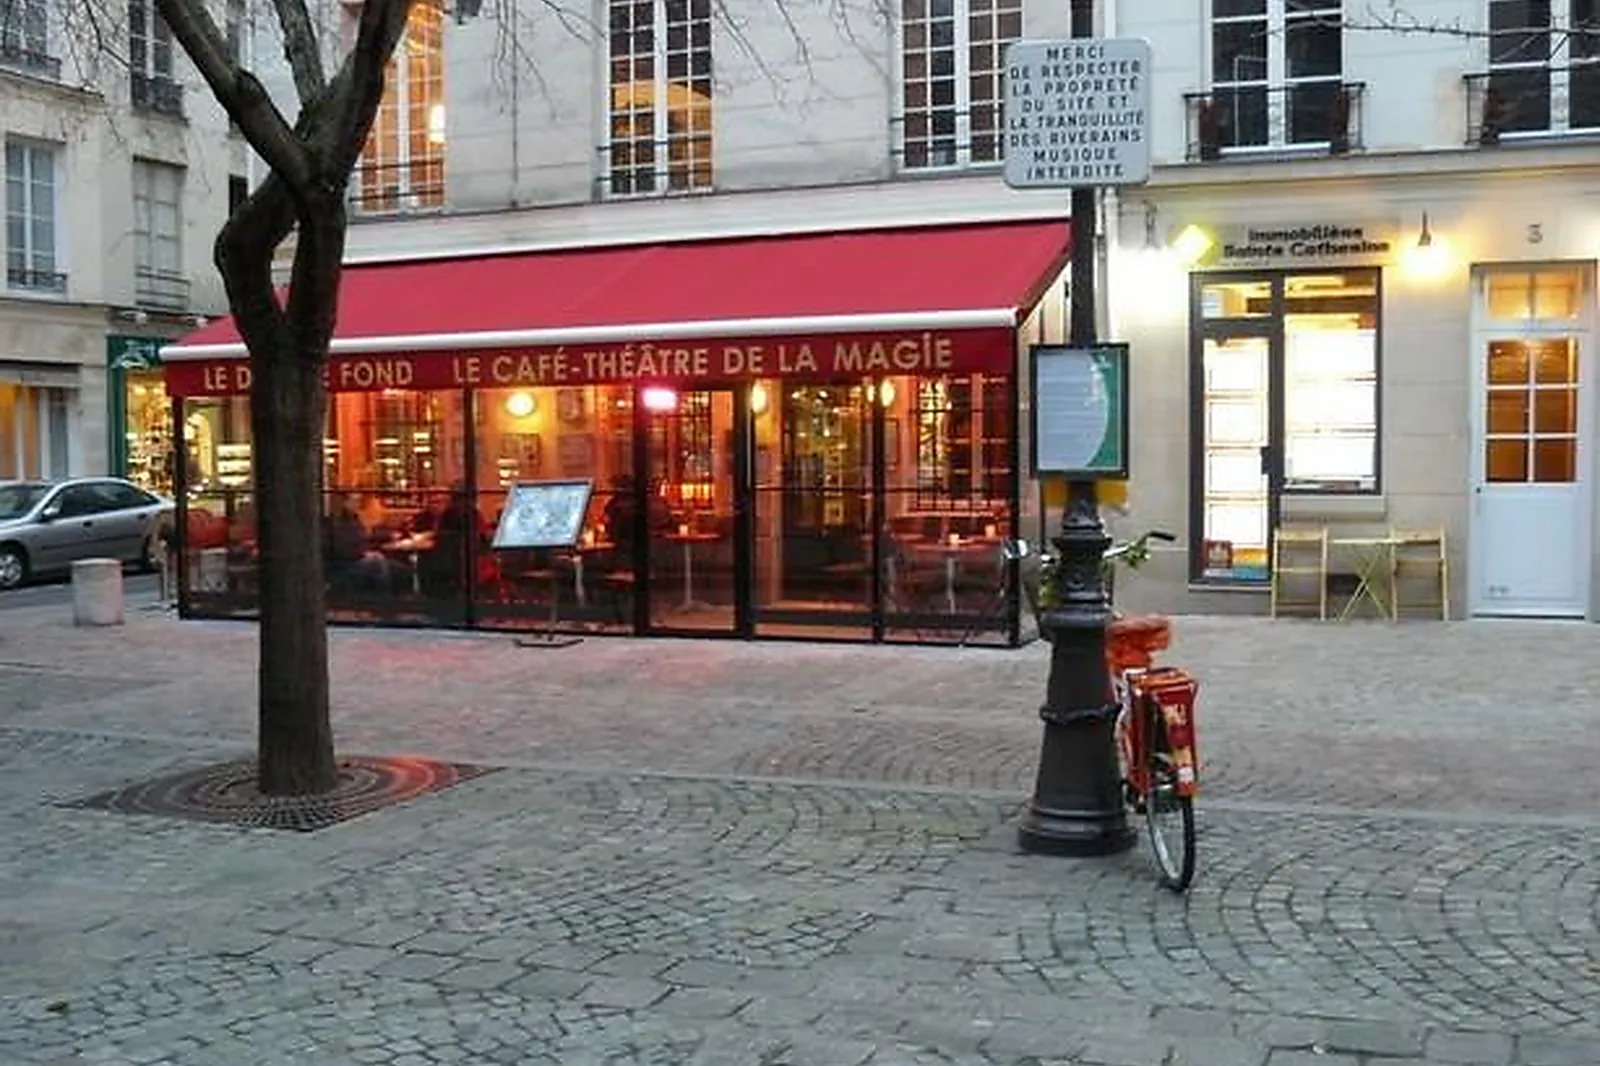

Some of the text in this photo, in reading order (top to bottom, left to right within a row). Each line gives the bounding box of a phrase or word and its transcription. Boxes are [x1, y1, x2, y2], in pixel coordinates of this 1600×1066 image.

[1046, 45, 1104, 61] MERCI
[1010, 60, 1141, 80] DE RESPECTER
[1012, 83, 1031, 97] LA
[1022, 96, 1127, 113] DU SITE ET
[1010, 117, 1029, 131] LA
[1010, 129, 1142, 148] DES RIVERAINS
[1033, 147, 1117, 162] MUSIQUE
[1027, 164, 1124, 181] INTERDITE
[453, 356, 481, 383] LE
[491, 344, 709, 383] CAFÉ-THÉÂTRE
[723, 346, 764, 374] DE
[778, 344, 818, 373] LA
[204, 366, 228, 391] LE
[340, 360, 413, 387] FOND
